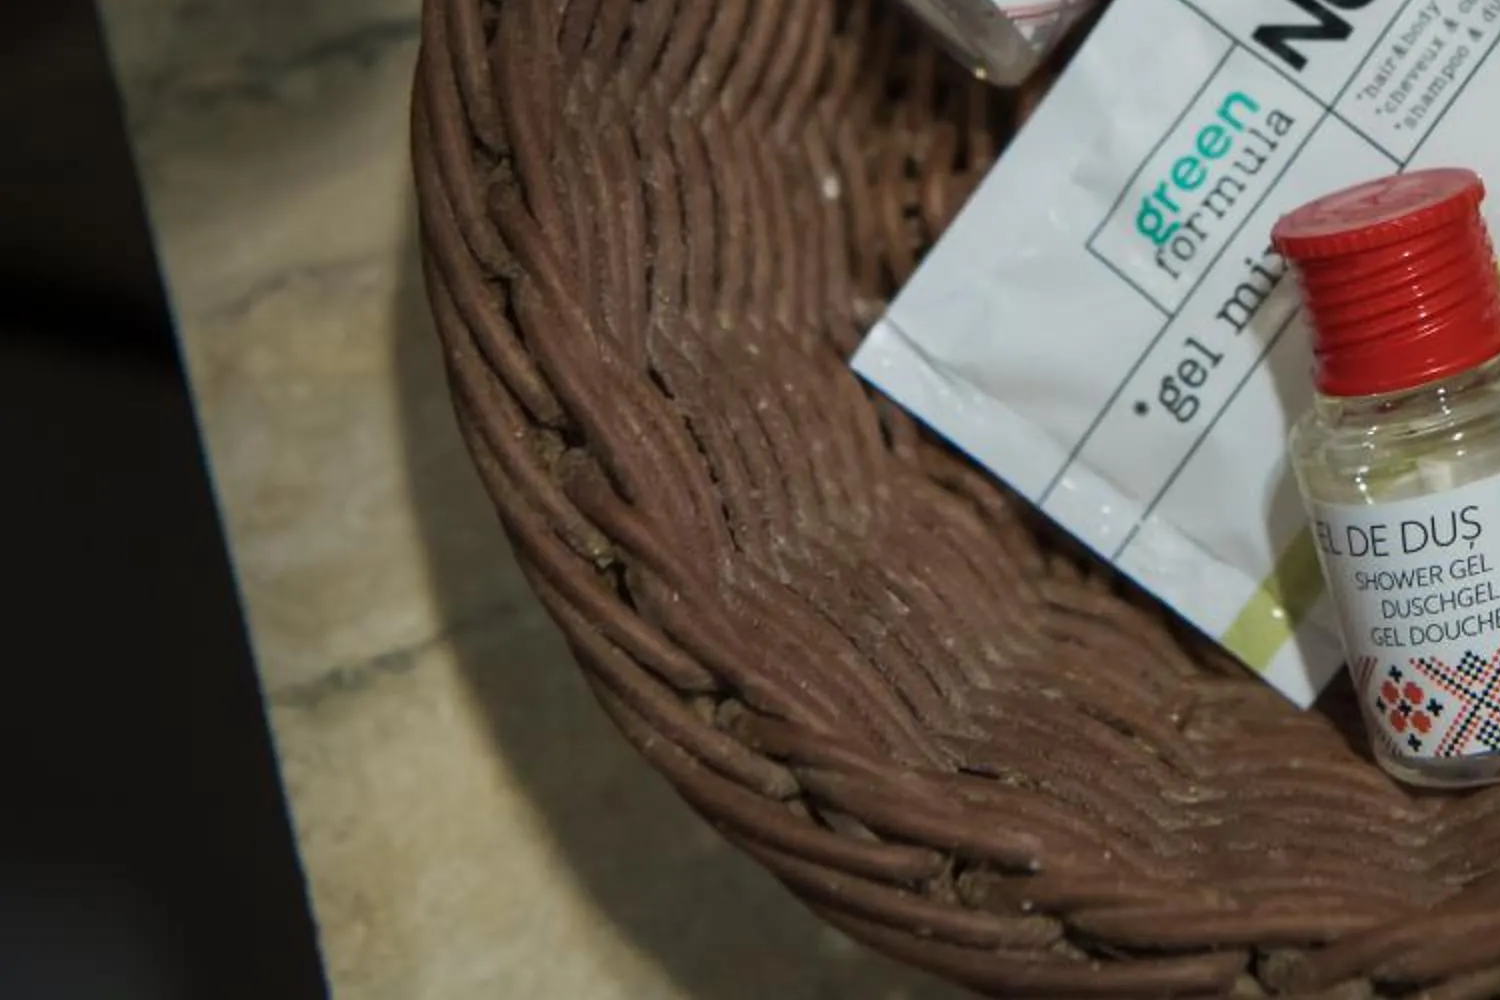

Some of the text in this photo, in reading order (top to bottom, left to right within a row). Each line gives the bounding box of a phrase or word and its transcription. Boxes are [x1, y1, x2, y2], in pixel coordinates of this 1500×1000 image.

[1136, 89, 1260, 247] green
[1153, 108, 1296, 280] formula
[1346, 525, 1389, 557] DE
[1354, 553, 1493, 591] SHOWER GEL
[1381, 581, 1500, 619] DUSCHGEL
[1370, 627, 1405, 647] GEL
